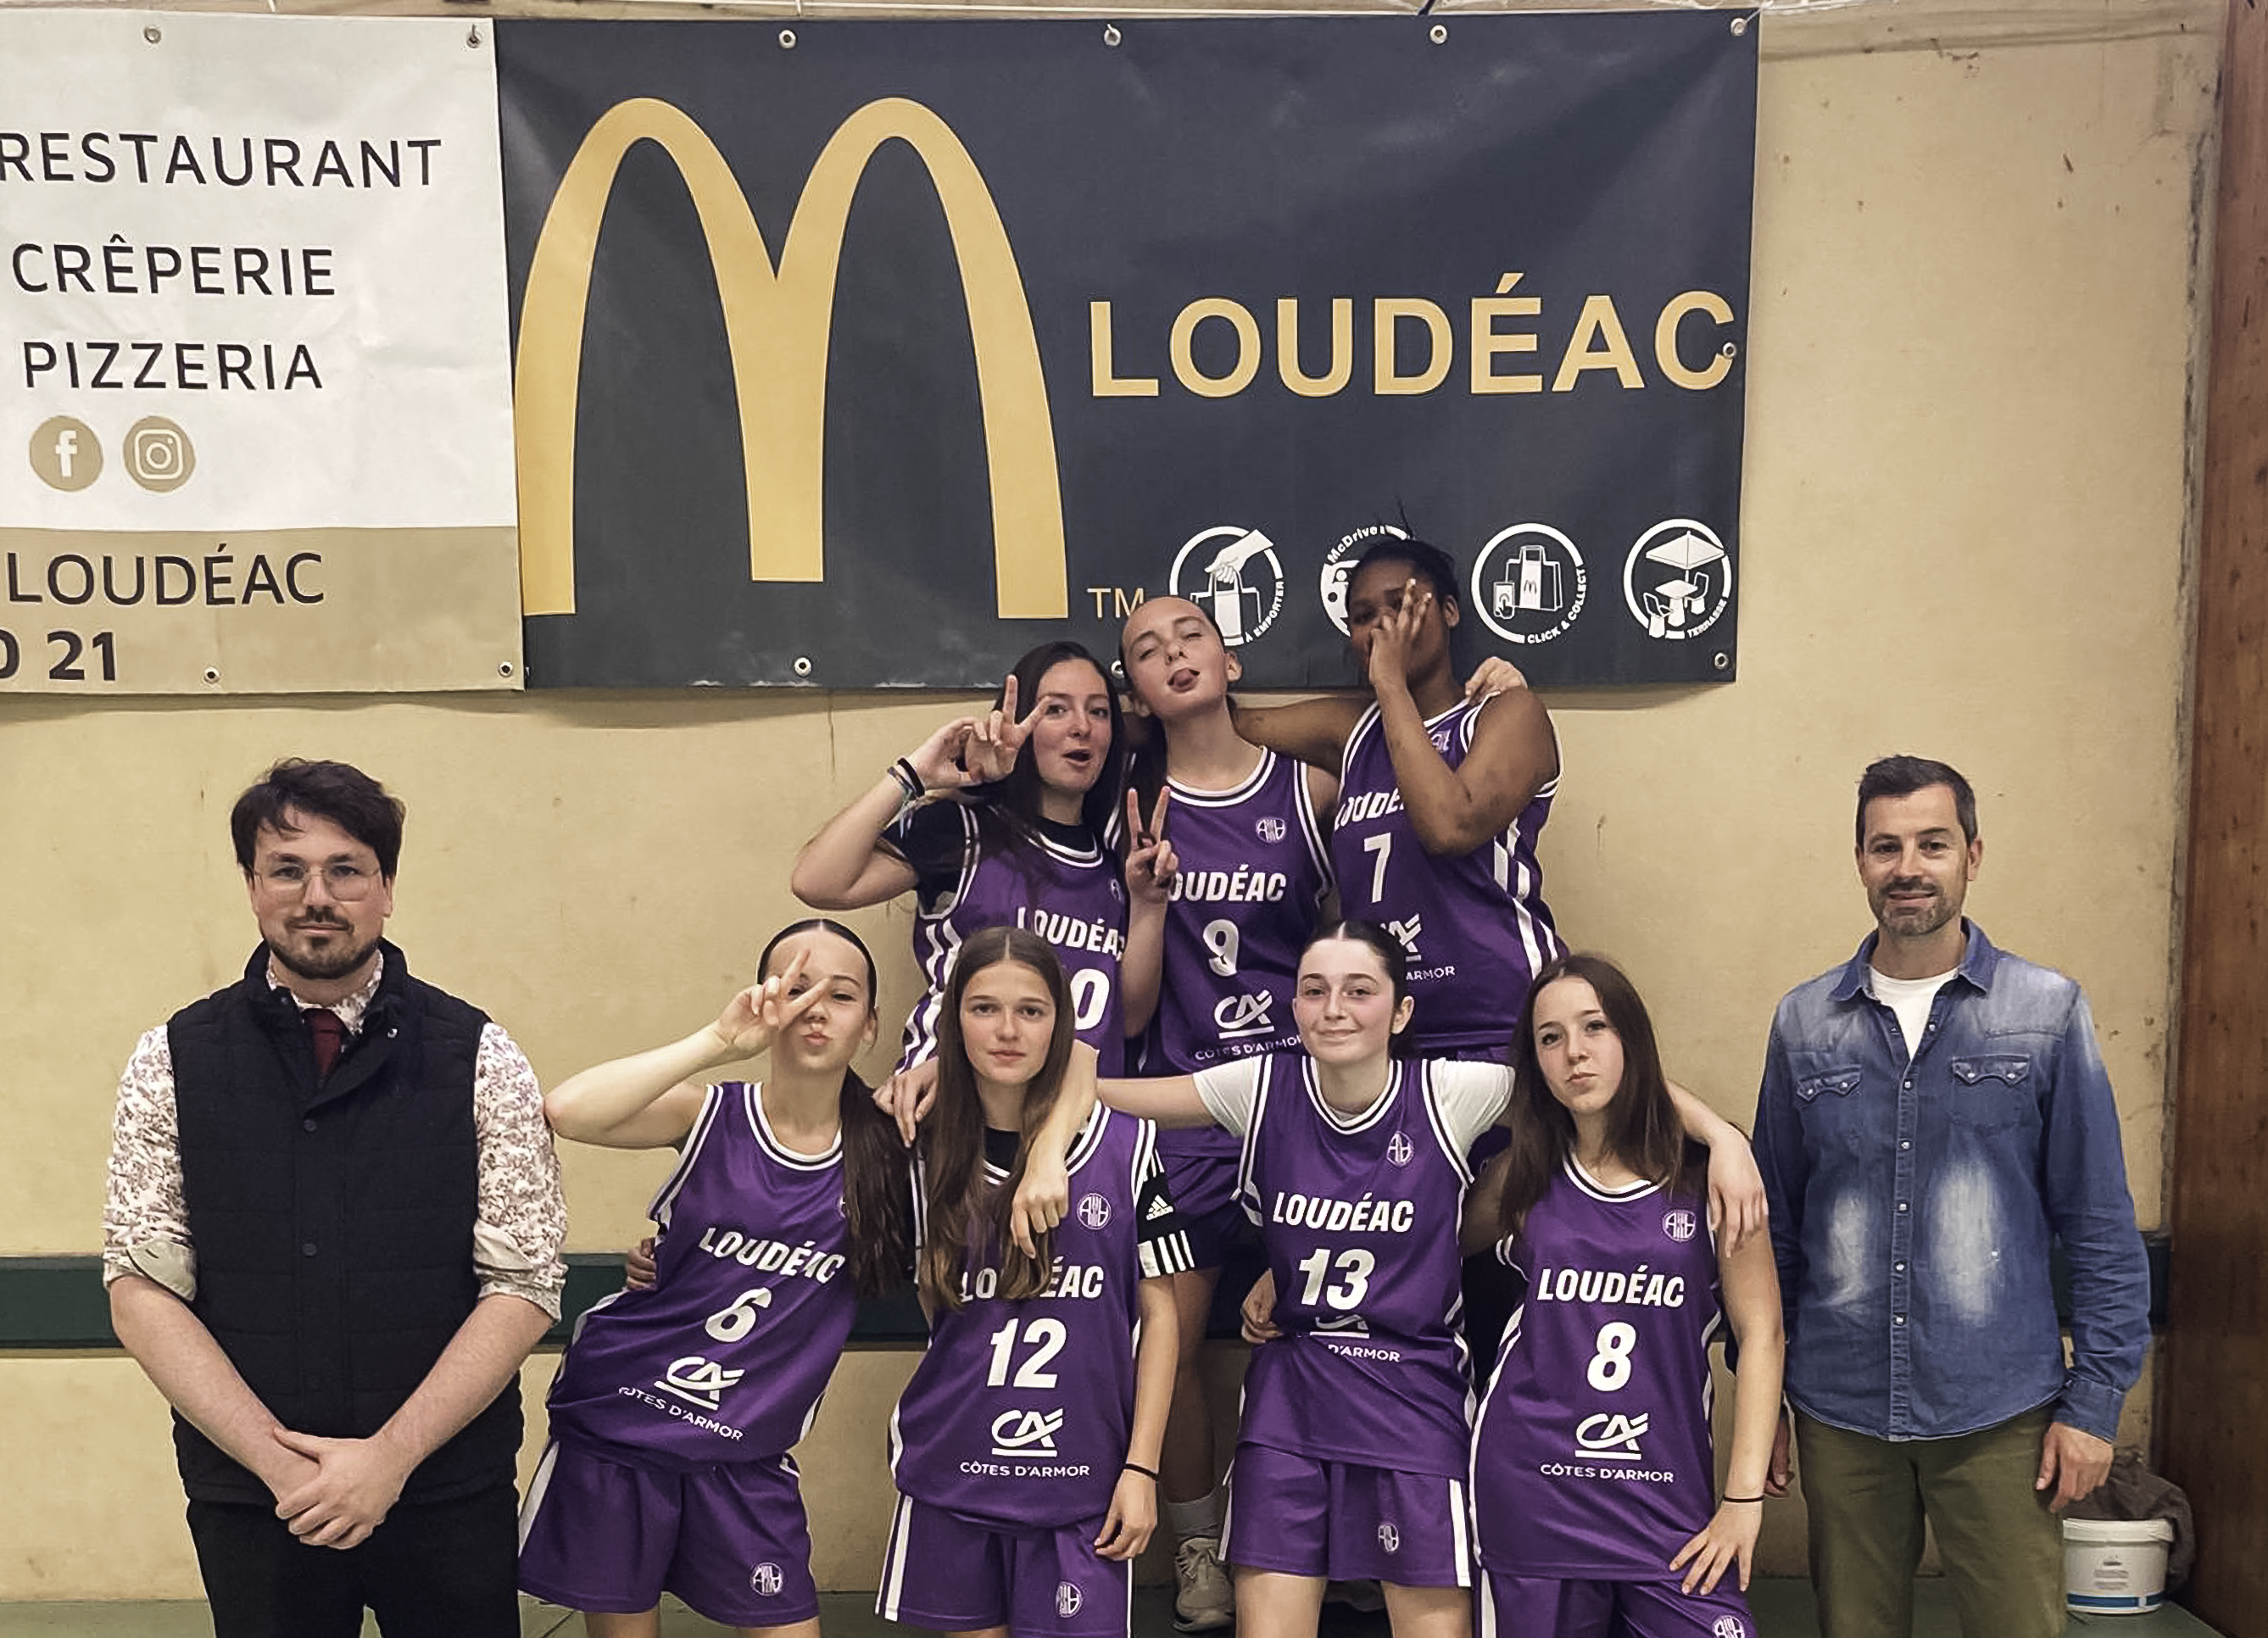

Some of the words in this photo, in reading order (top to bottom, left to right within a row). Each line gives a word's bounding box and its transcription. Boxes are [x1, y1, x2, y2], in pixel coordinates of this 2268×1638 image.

[0, 132, 441, 188] RESTAURANT
[12, 233, 337, 296] CRÊPERIE
[1089, 273, 1735, 398] LOUDÉAC
[24, 342, 323, 391] PIZZERIA
[1327, 526, 1378, 563] McDrive
[8, 543, 325, 607] LOUDÉAC
[1087, 588, 1145, 619] TM
[1253, 582, 1284, 637] EMPORTER
[1527, 626, 1561, 644] CLICK
[1561, 621, 1570, 630] &
[1568, 568, 1586, 621] COLLECT
[47, 631, 115, 681] 21
[1168, 864, 1287, 902] OUDÉAC
[1364, 833, 1391, 903] 7
[1202, 919, 1240, 977] 9
[1406, 966, 1456, 981] ARMOR
[1070, 968, 1110, 1031] 0
[1273, 1192, 1414, 1233] LOUDÉAC
[959, 1256, 1104, 1302] LOÉAC
[1299, 1248, 1375, 1311] 13
[1537, 1265, 1685, 1307] LOUDÉAC
[705, 1287, 772, 1342] 6
[987, 1318, 1067, 1389] 12
[1587, 1322, 1636, 1391] 8
[668, 1404, 744, 1441] D'ARMOR
[960, 1460, 1011, 1477] CÔTES
[1015, 1465, 1090, 1478] D'ARMOR
[1541, 1462, 1596, 1479] CÔTES
[1600, 1468, 1675, 1484] D'ARMOR
